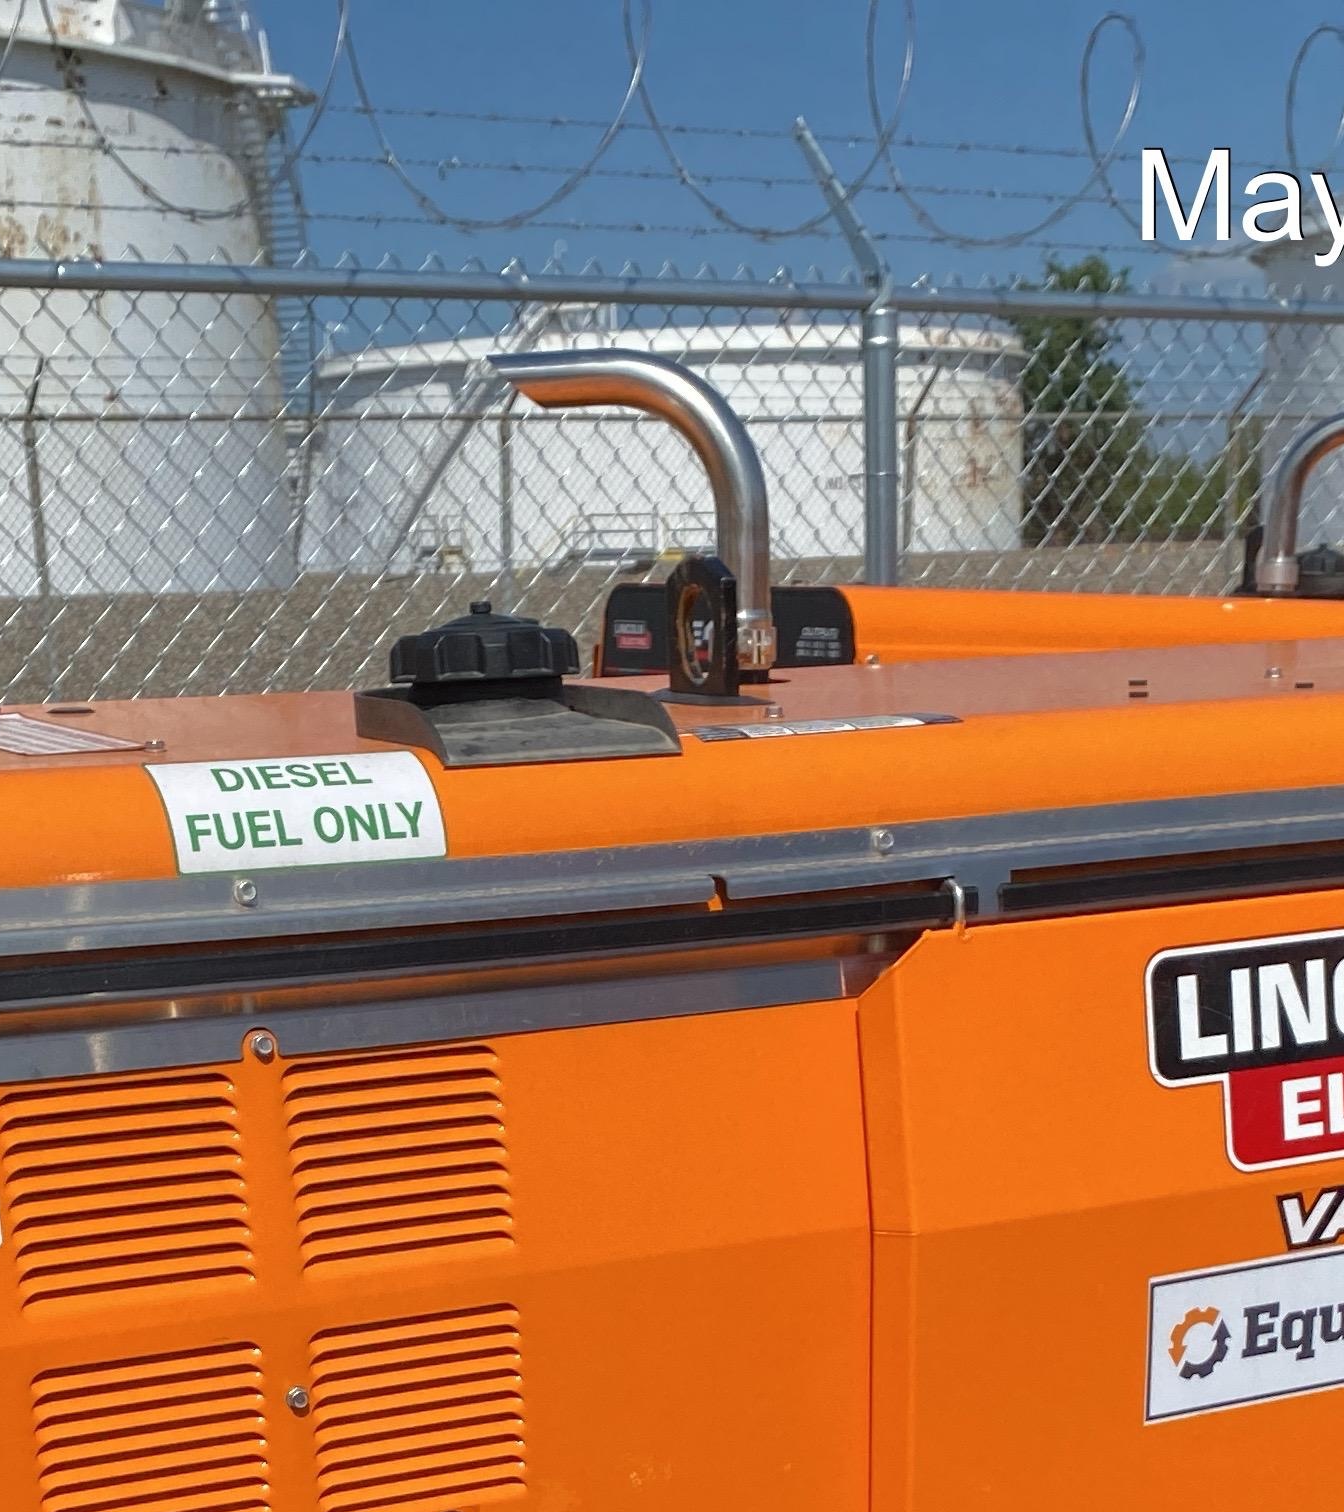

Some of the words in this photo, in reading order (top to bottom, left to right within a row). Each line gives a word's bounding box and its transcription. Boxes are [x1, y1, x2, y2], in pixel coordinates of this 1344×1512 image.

[210, 761, 373, 792] DIESEL
[185, 809, 303, 852] FUEL
[313, 801, 423, 843] ONLY
